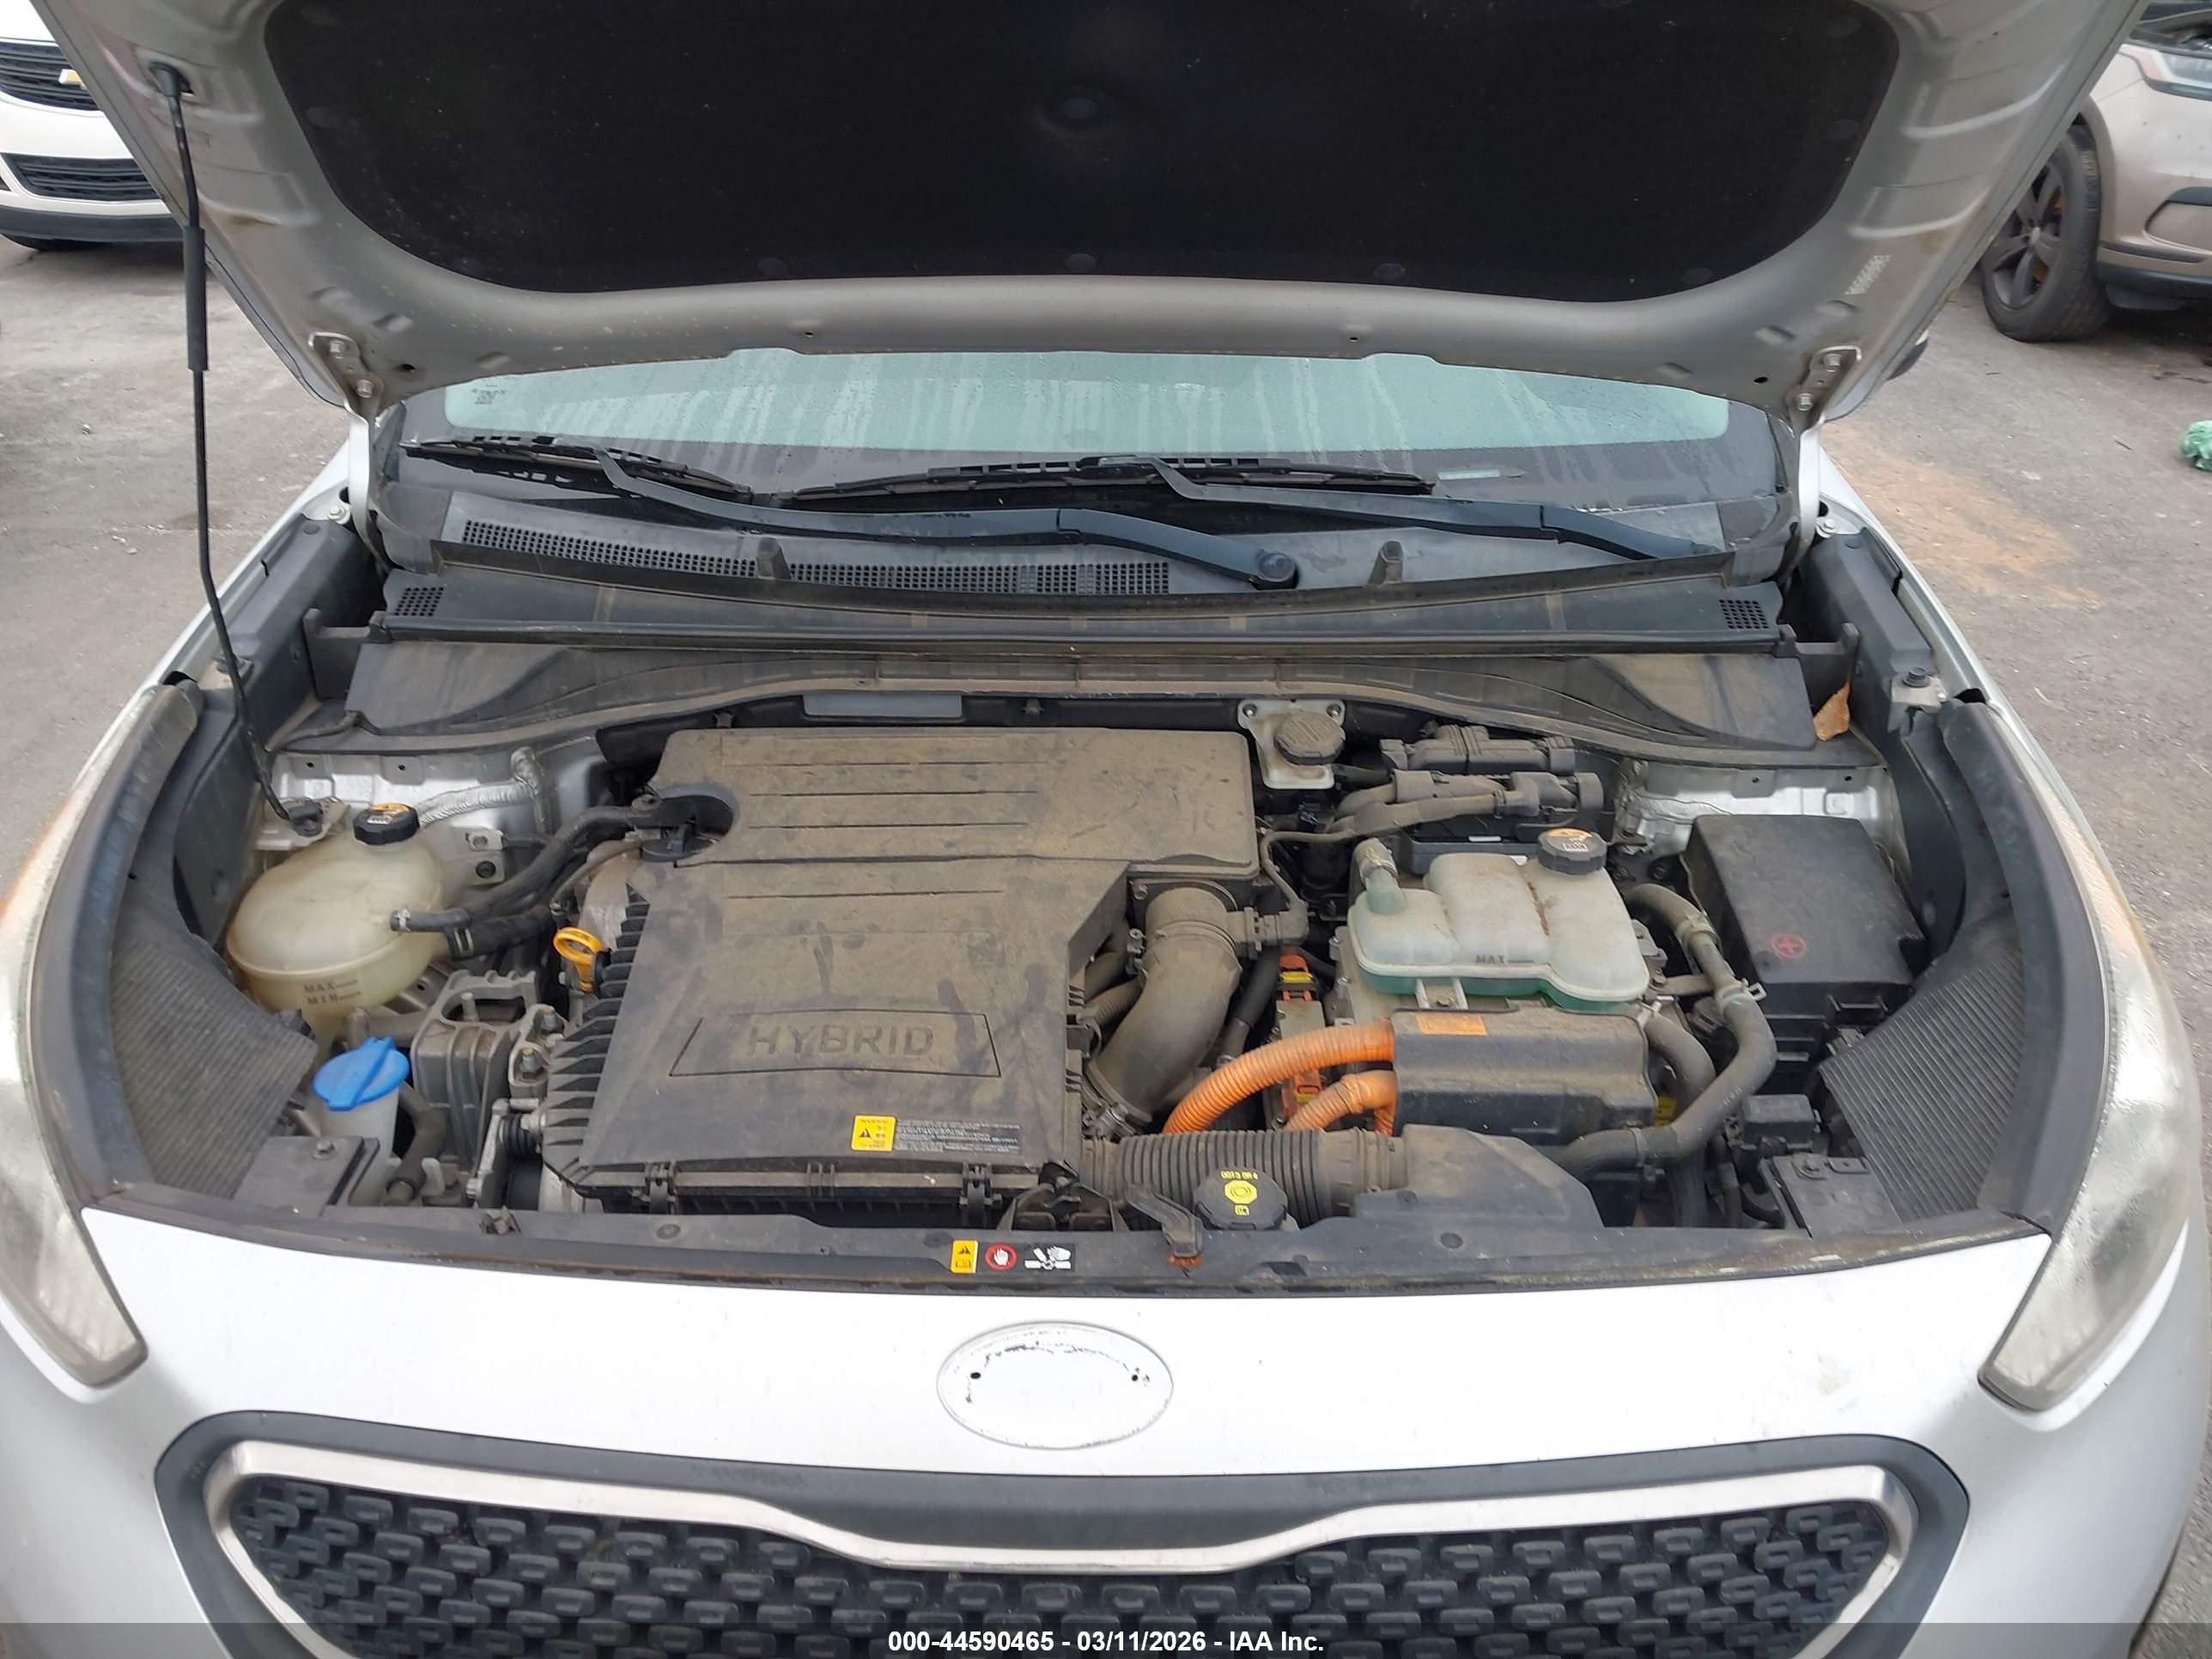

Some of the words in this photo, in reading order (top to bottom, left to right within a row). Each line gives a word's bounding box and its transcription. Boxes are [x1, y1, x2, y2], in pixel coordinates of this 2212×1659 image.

[1475, 954, 1504, 963] MAX
[303, 981, 335, 993] MAX
[307, 994, 338, 1004] MIN
[746, 1024, 934, 1056] HYBRID
